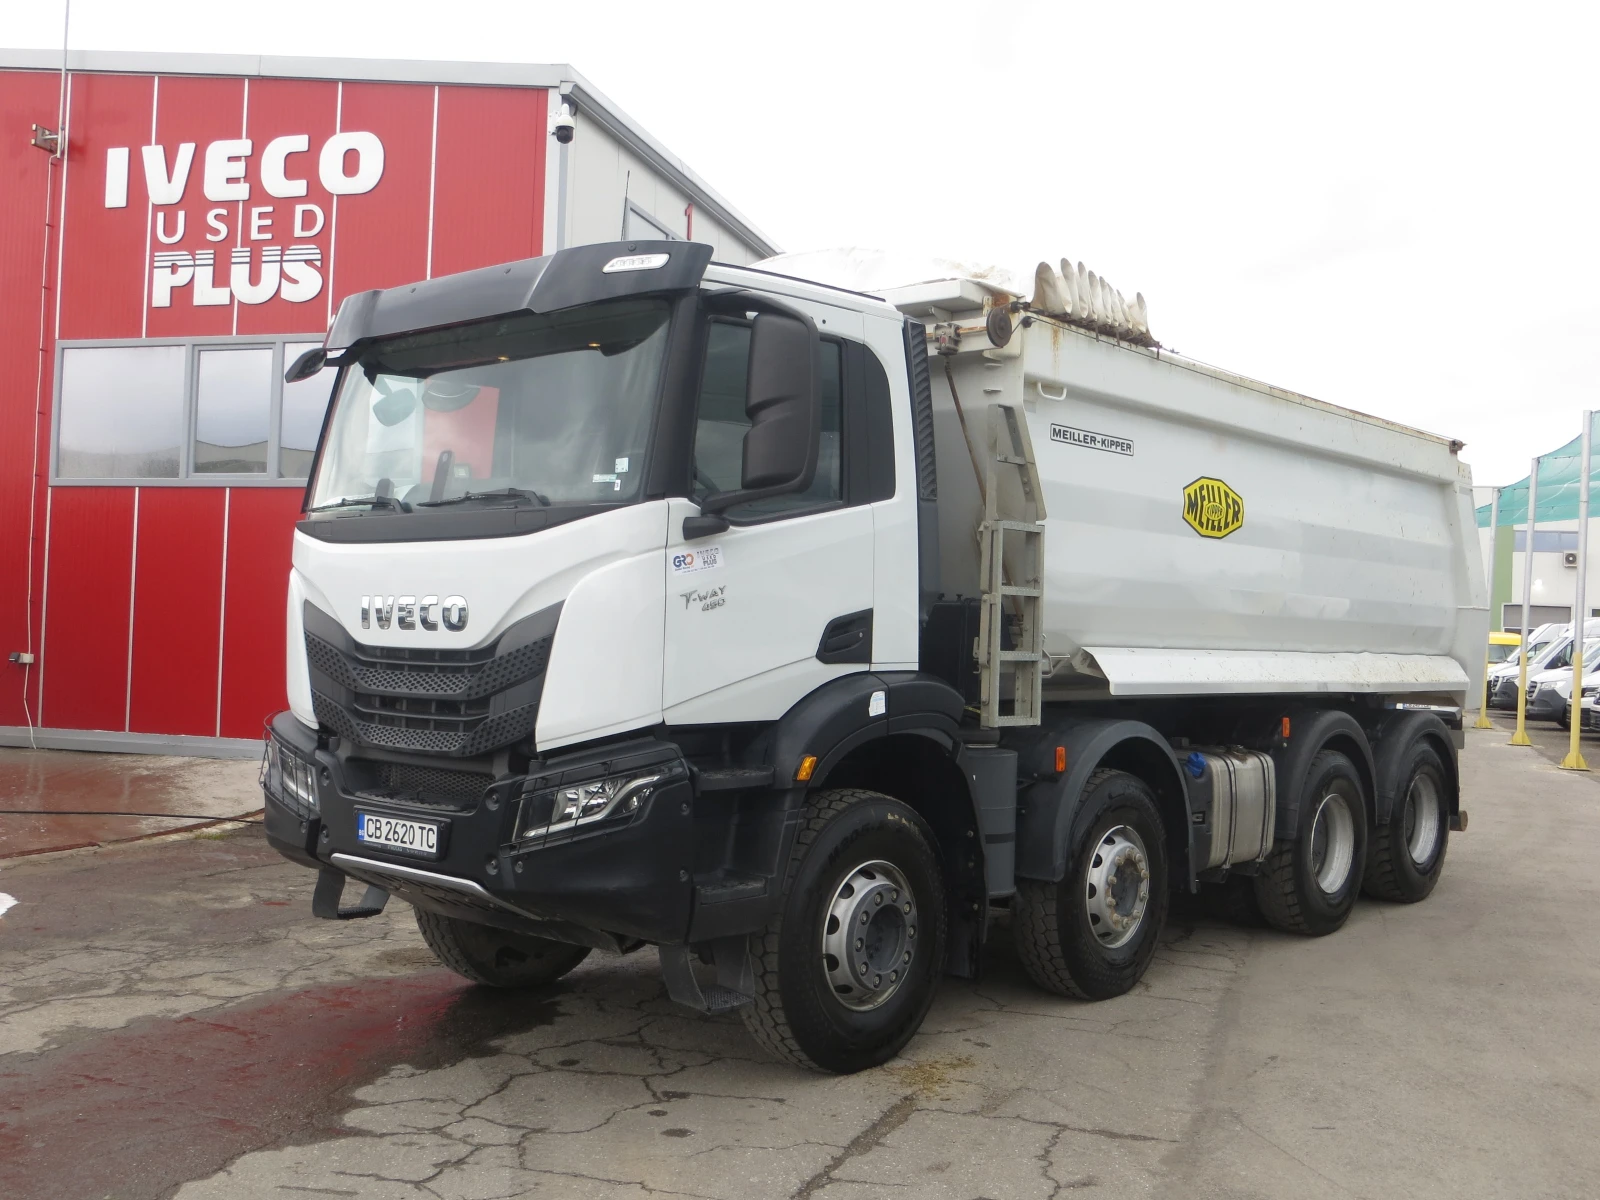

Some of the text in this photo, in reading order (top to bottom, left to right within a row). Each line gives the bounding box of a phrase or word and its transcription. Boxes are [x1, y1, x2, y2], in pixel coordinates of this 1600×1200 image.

[105, 131, 385, 208] IVECO
[156, 203, 325, 244] USED
[152, 244, 324, 307] PLUS
[1052, 427, 1132, 453] MEILLER-KIPPER
[1187, 484, 1241, 532] MEILLER
[361, 595, 469, 632] IVECO
[680, 585, 726, 610] T-WAY
[366, 818, 382, 839] CB
[385, 820, 415, 845] 2620
[419, 825, 435, 849] TC
